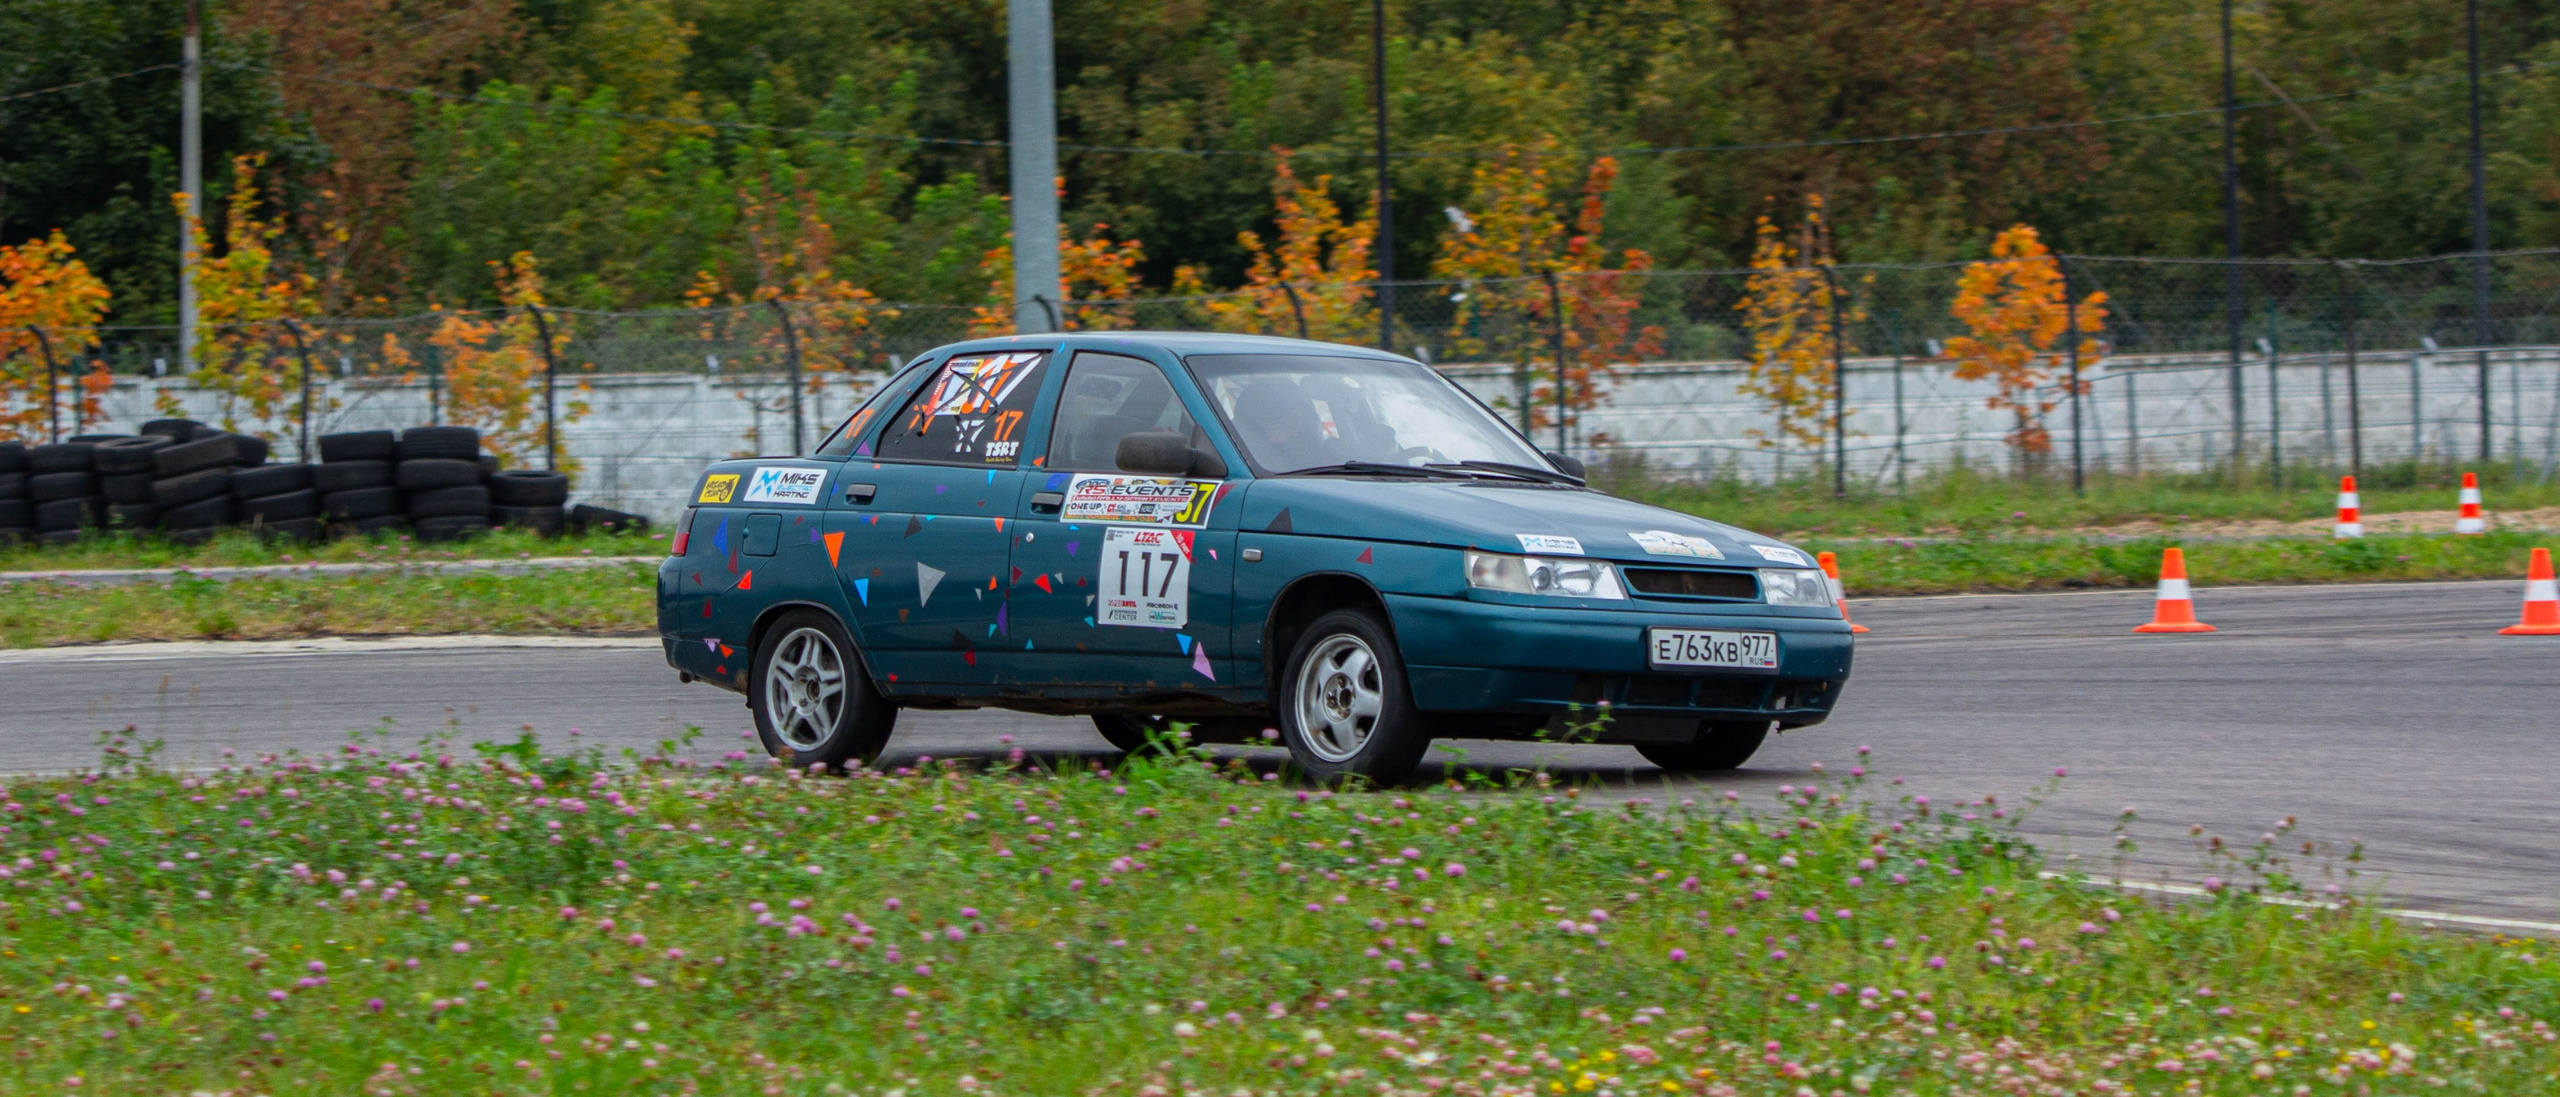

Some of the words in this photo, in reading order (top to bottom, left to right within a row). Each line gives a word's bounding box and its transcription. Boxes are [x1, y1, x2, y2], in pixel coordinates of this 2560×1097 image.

[845, 408, 875, 440] 17
[993, 410, 1024, 441] 17
[985, 442, 1019, 457] TSRT
[780, 473, 820, 485] MIKS
[773, 491, 809, 499] KARTING
[1110, 485, 1195, 496] EVENTS
[1134, 532, 1165, 543] LTAC
[1118, 550, 1179, 598] 117
[1742, 635, 1770, 657] 977
[1749, 658, 1764, 666] RUS
